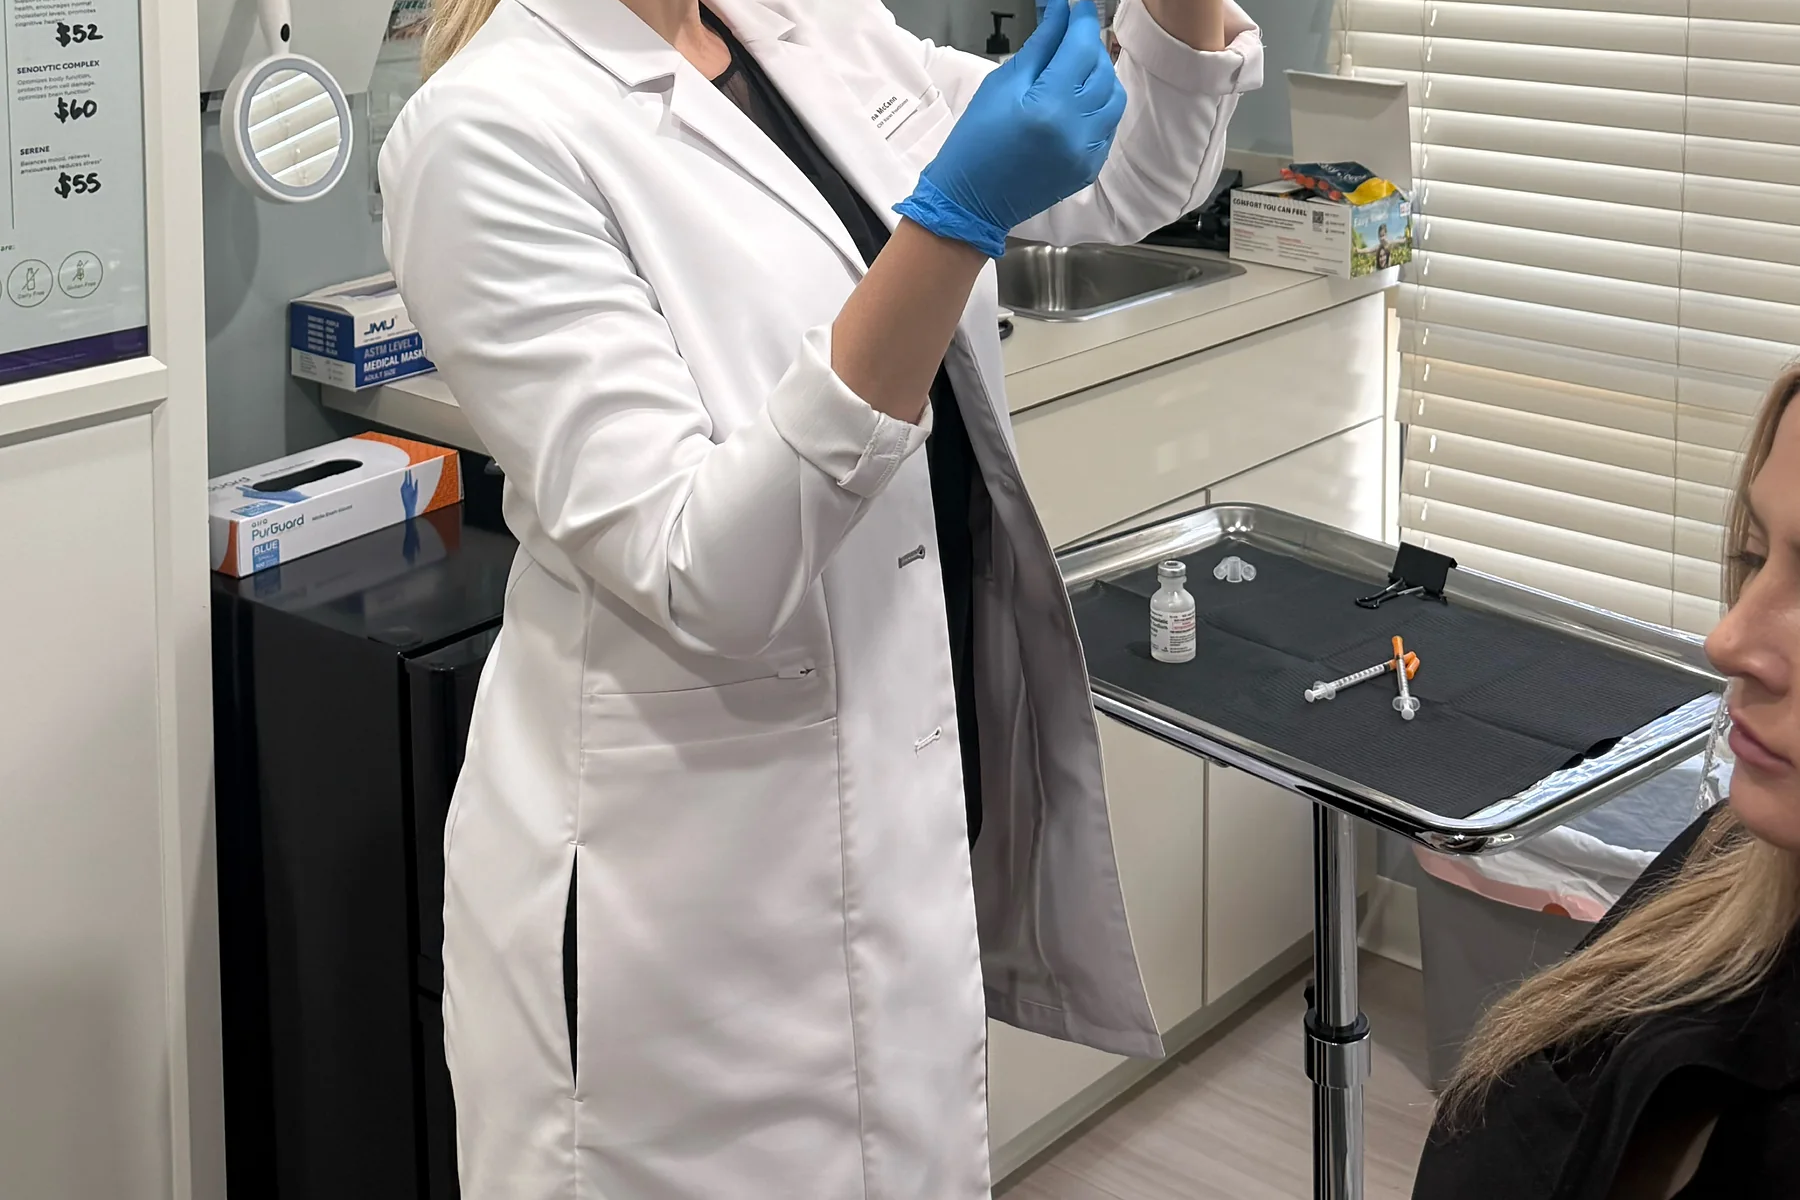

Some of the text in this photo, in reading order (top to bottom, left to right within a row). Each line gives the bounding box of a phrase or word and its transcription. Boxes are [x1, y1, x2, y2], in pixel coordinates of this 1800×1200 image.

[55, 22, 104, 48] $52
[17, 59, 100, 74] SENOLYTIC COMPLEX
[54, 96, 98, 124] $60
[20, 145, 50, 156] SERENE
[54, 171, 102, 199] $55
[1233, 197, 1308, 217] COMFORT YOU CAN FEEL
[364, 343, 388, 360] ASTM
[388, 336, 412, 352] LEVEL
[363, 355, 400, 373] MEDICAL
[364, 371, 382, 382] ADULT
[252, 513, 305, 541] PurGuard
[254, 540, 279, 556] BLUE
